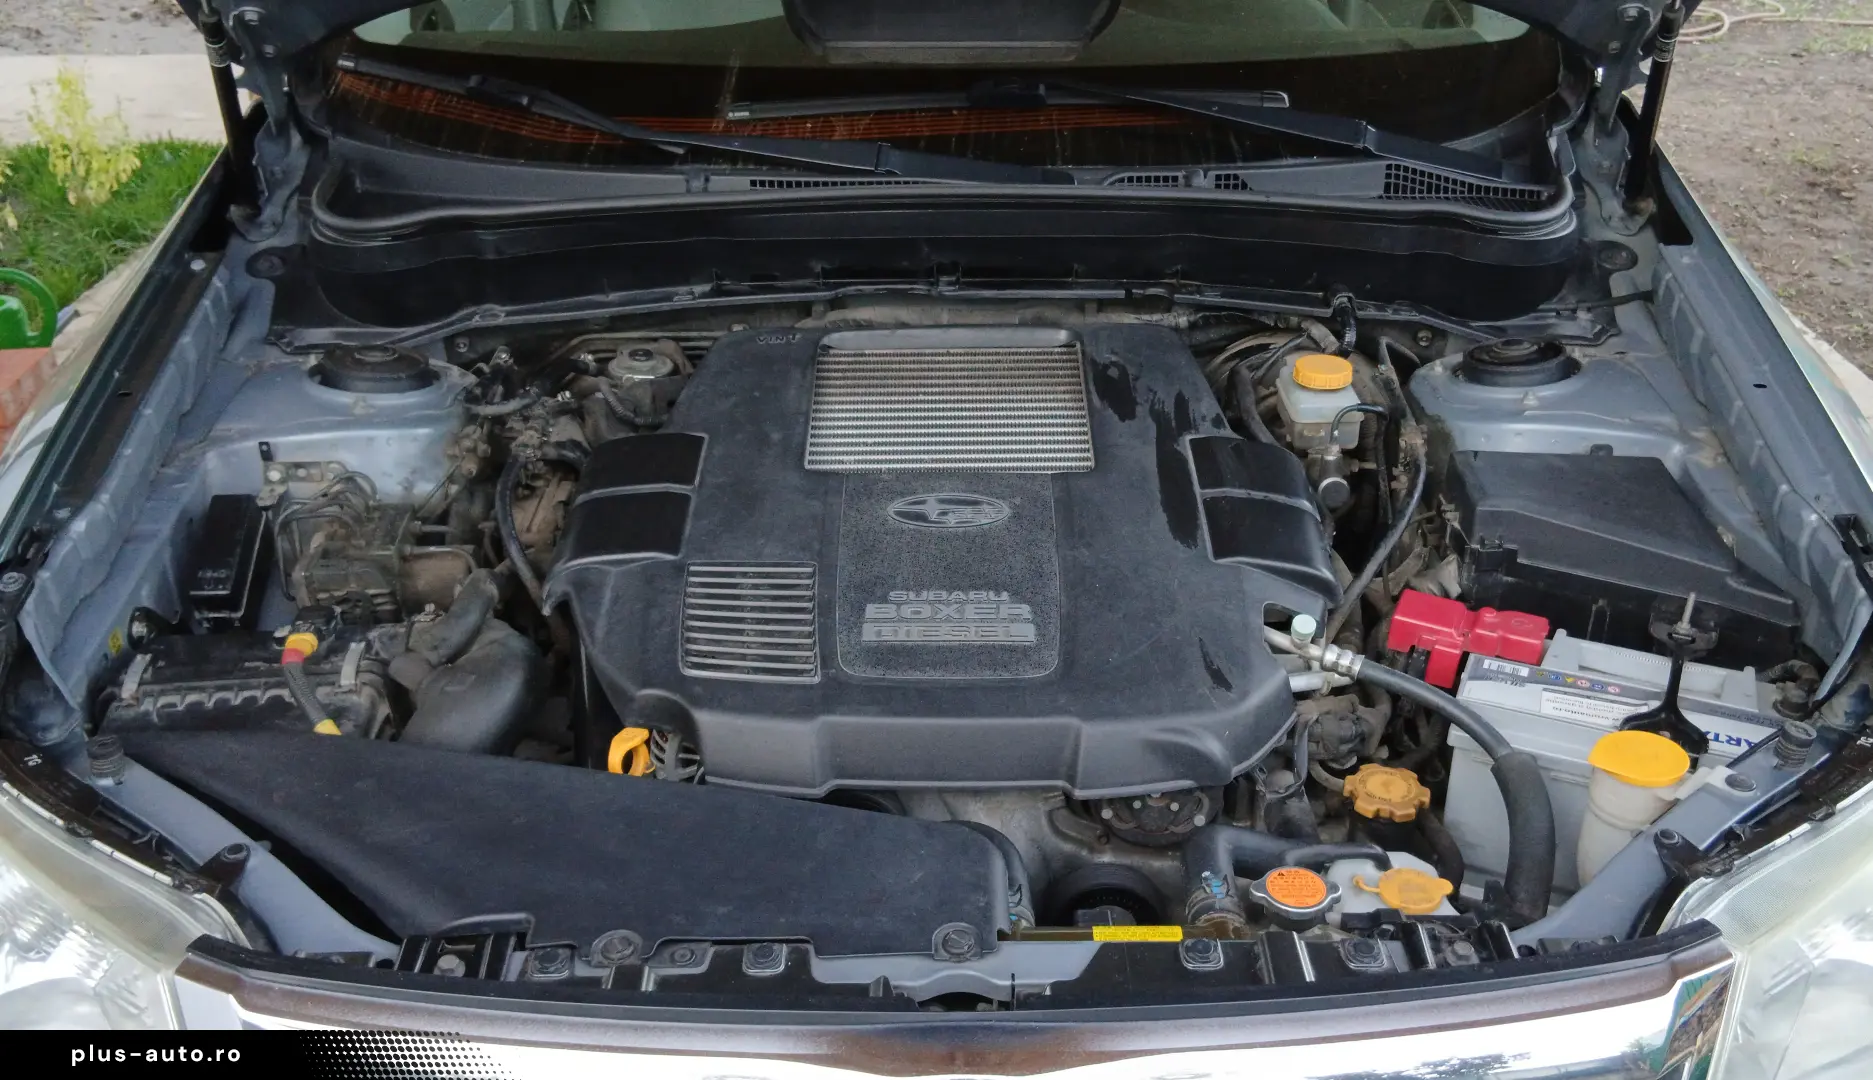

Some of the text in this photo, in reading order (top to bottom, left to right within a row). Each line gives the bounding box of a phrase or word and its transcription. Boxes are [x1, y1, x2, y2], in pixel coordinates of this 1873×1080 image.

[888, 590, 1011, 602] SUBARU
[864, 603, 1032, 621] BOXER
[870, 624, 1032, 640] DIESEL
[1703, 730, 1756, 748] ART
